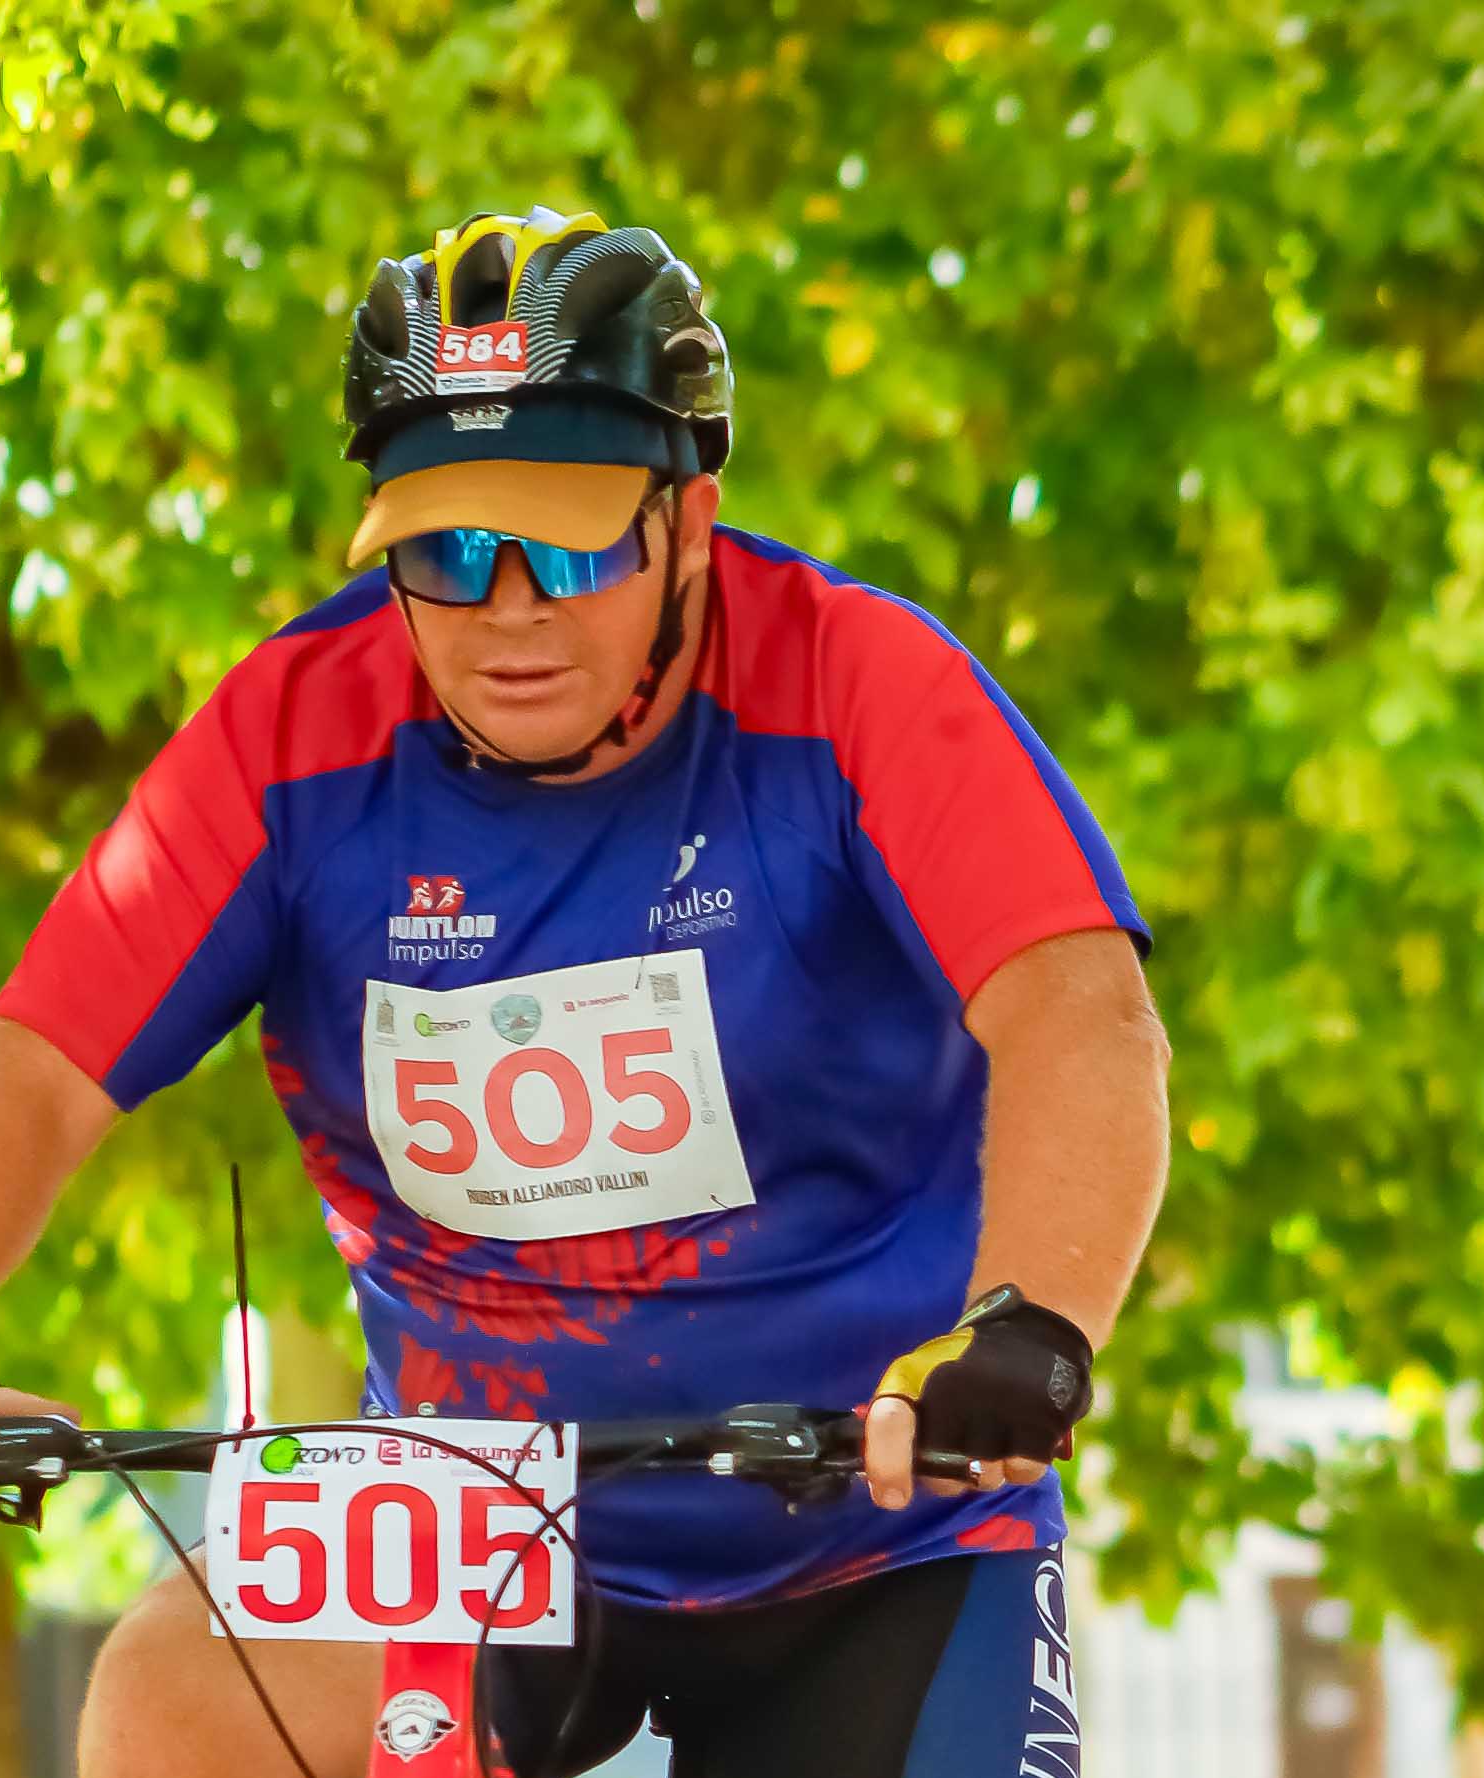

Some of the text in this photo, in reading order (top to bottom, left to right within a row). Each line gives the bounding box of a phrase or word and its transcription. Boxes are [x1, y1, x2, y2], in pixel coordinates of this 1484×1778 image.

[441, 332, 523, 364] 584
[394, 1028, 692, 1175] 505
[512, 1177, 592, 1203] ALEJANDRO
[595, 1171, 649, 1192] VALLINI
[238, 1482, 551, 1629] 505
